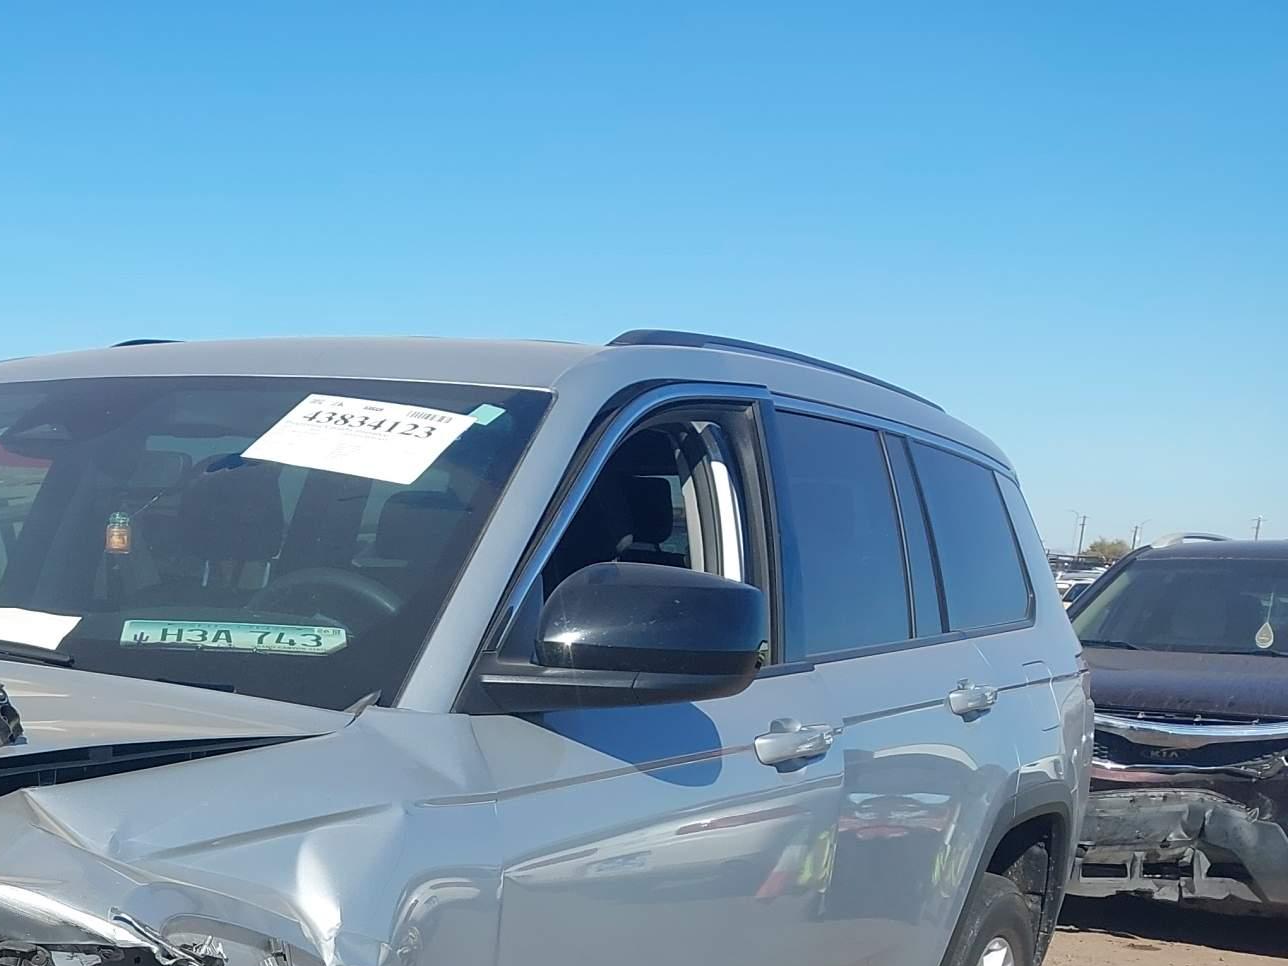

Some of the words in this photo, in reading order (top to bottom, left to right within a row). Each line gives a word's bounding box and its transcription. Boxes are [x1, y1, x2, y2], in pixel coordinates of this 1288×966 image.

[302, 409, 438, 440] 43834123
[159, 627, 234, 645] H3A
[249, 629, 323, 649] 743
[1150, 750, 1179, 760] KIA
